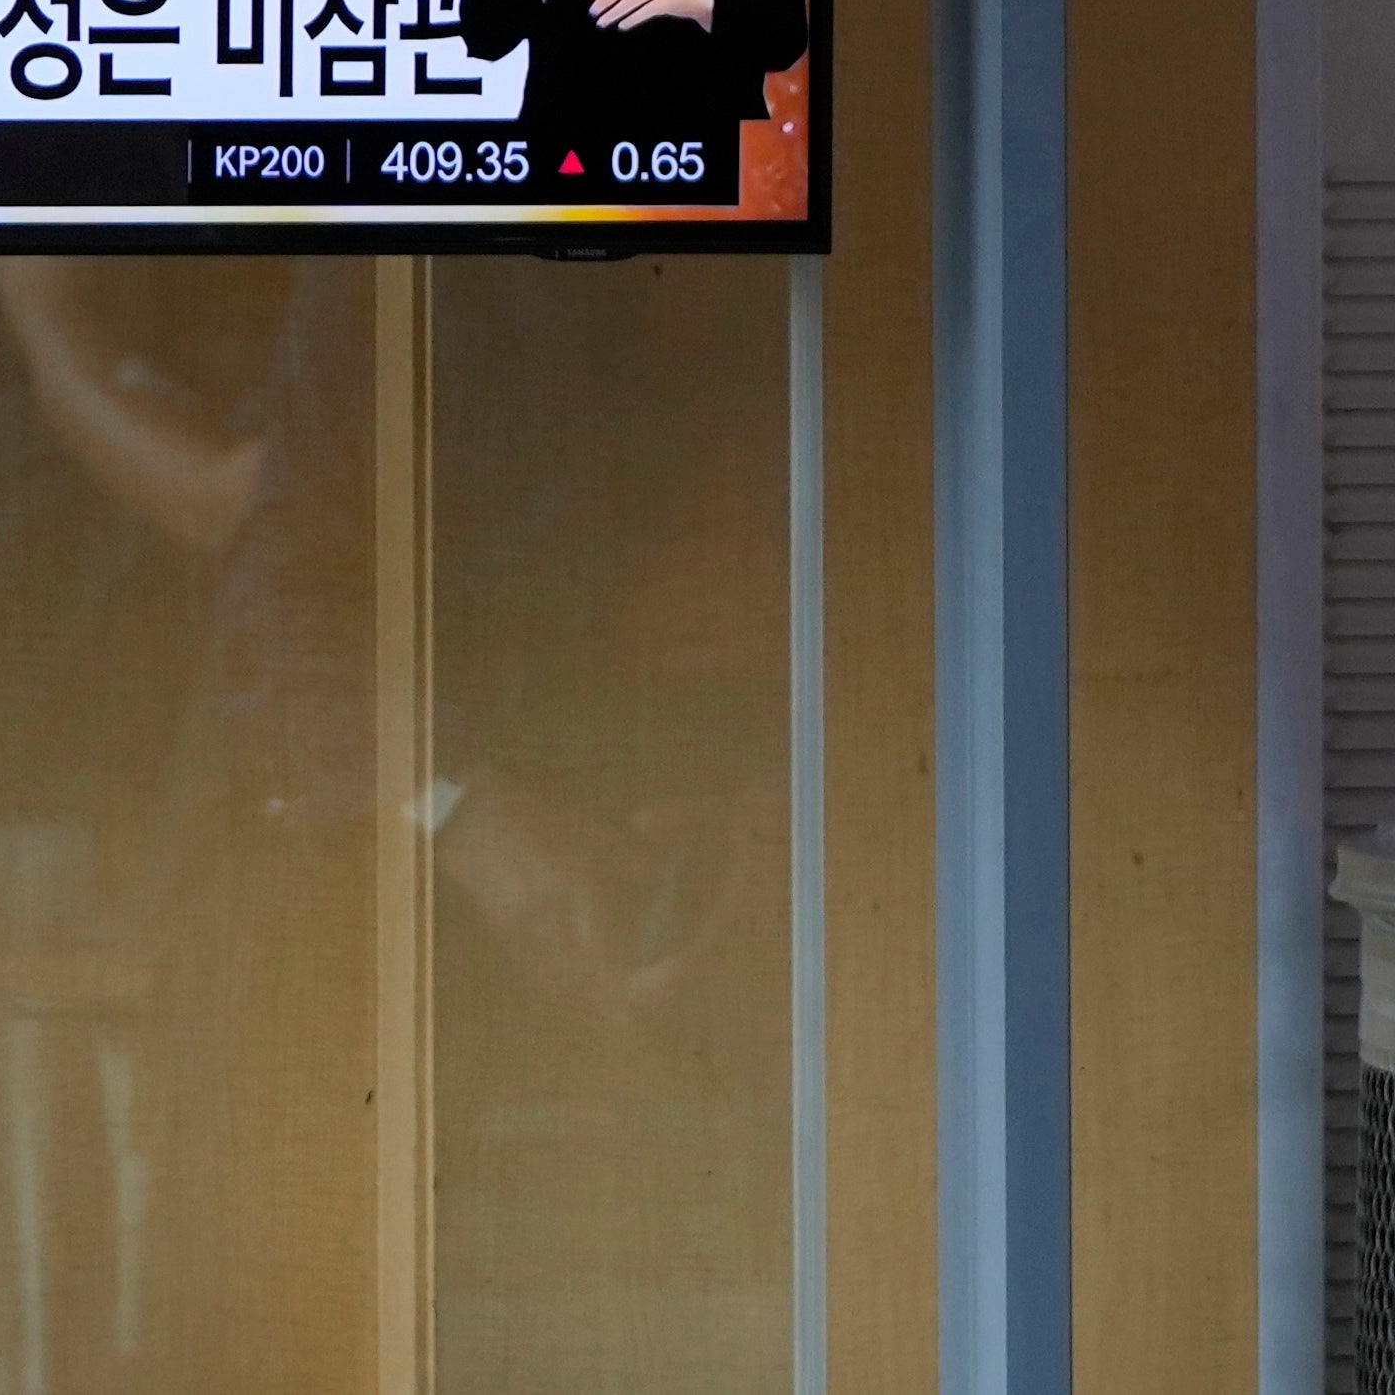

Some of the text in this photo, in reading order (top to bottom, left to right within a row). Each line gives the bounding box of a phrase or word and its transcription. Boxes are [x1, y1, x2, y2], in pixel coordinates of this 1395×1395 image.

[216, 141, 704, 181] KP200 409.35 0.65
